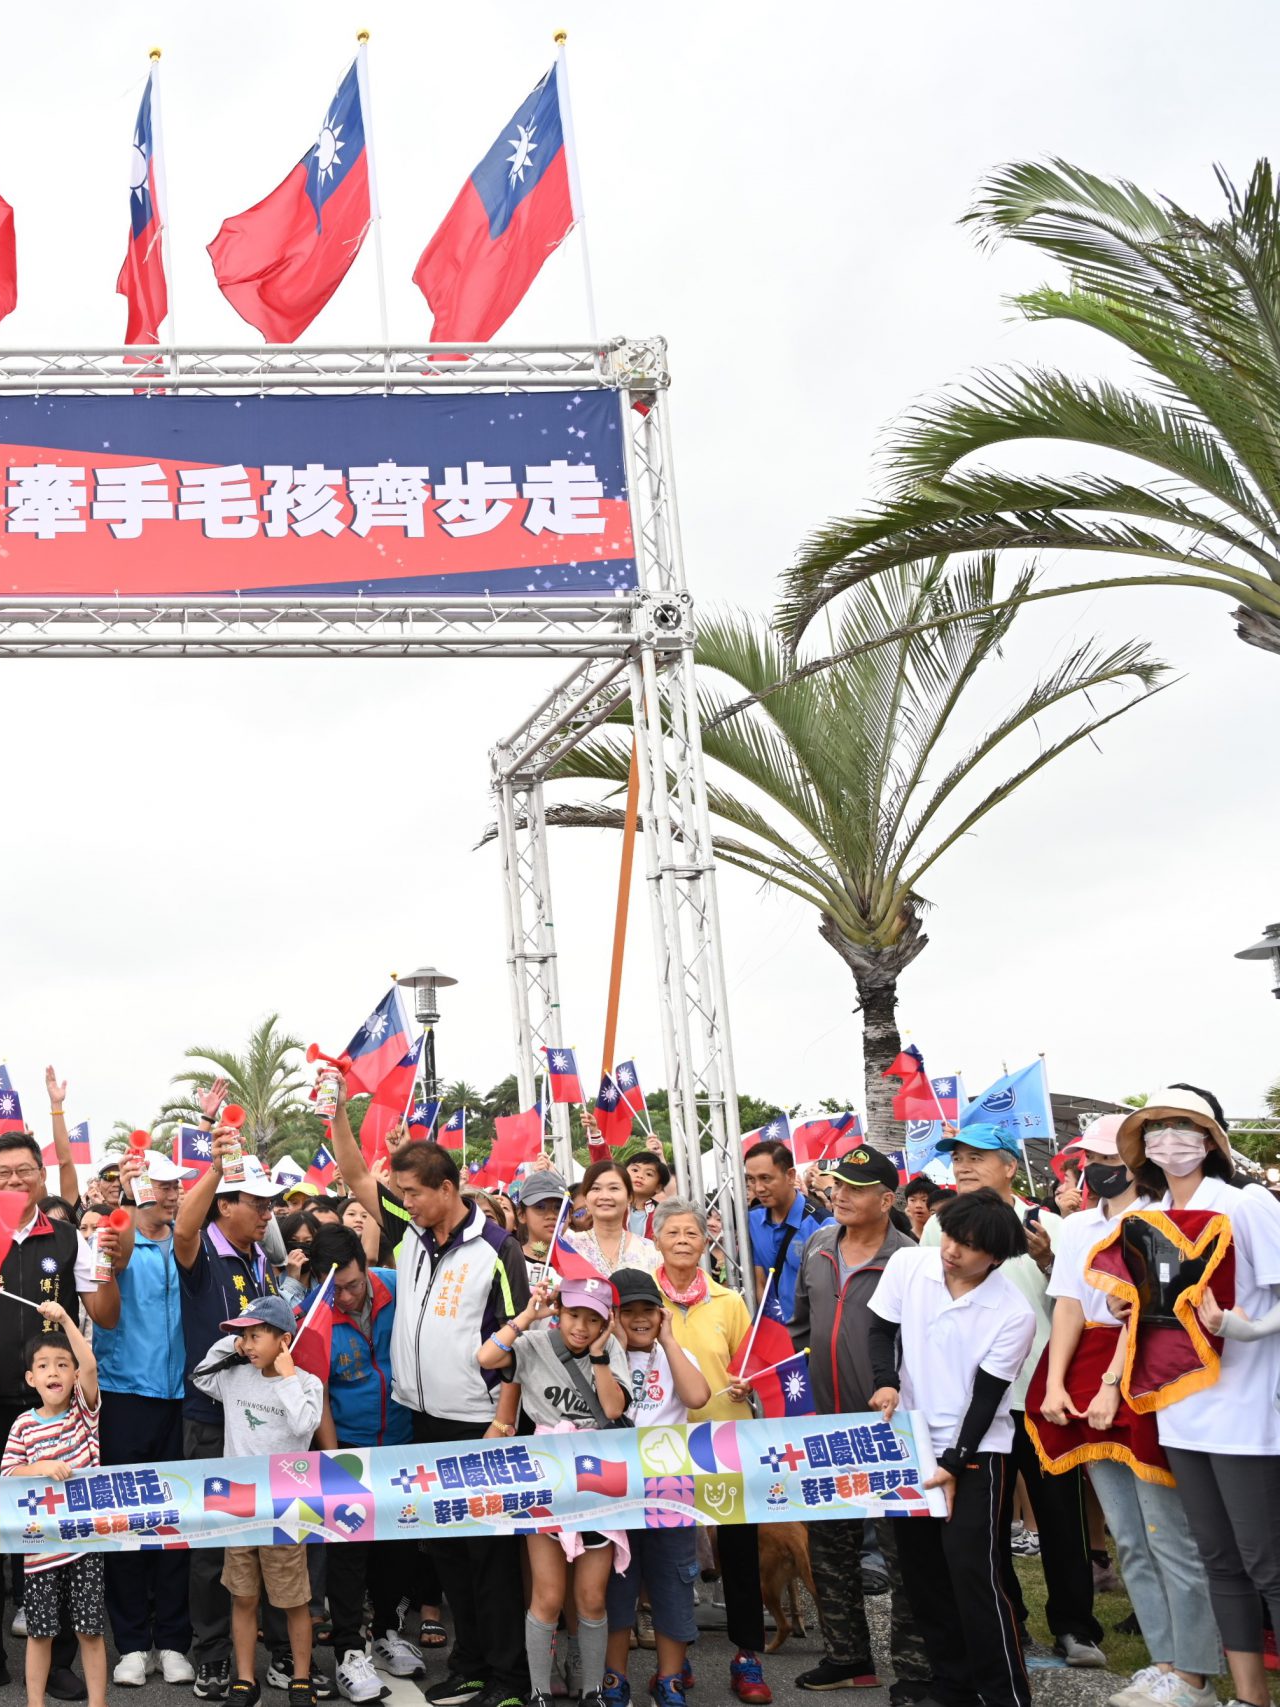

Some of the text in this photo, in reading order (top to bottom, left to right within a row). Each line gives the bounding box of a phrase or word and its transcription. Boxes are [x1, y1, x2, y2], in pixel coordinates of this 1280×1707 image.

[6, 460, 607, 540] 牽手毛孩齊步走
[584, 1278, 600, 1293] P
[800, 1468, 919, 1506] 牽手毛孩齊步走
[58, 1509, 180, 1541] 牽手毛孩齊步走
[433, 1489, 553, 1525] 牽手毛孩齊步走
